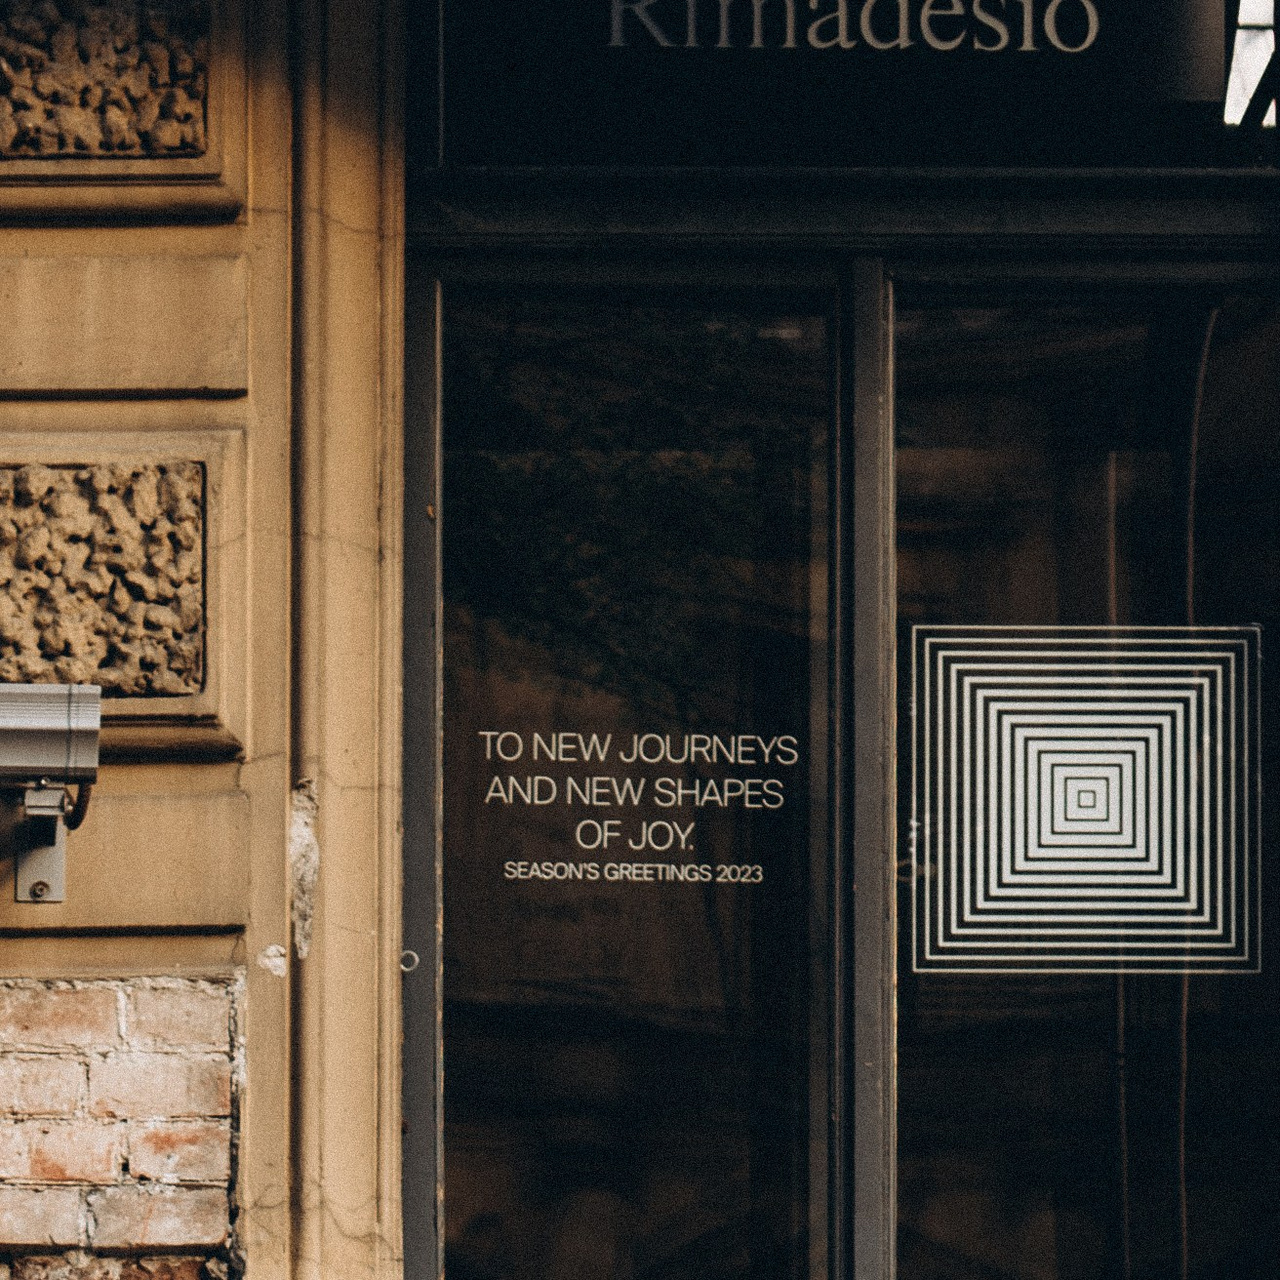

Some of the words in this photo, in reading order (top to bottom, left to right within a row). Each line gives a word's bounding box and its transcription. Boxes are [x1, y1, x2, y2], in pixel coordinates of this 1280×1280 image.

[478, 731, 524, 762] TO
[532, 732, 612, 763] NEW
[618, 733, 799, 765] JOURNEYS
[484, 775, 558, 805] AND
[566, 776, 646, 806] NEW
[653, 777, 785, 809] SHAPES
[575, 819, 622, 850] OF
[628, 820, 696, 851] JOY.
[504, 861, 600, 881] SEASON'S
[603, 862, 712, 883] GREETINGS
[715, 864, 764, 883] 2023
